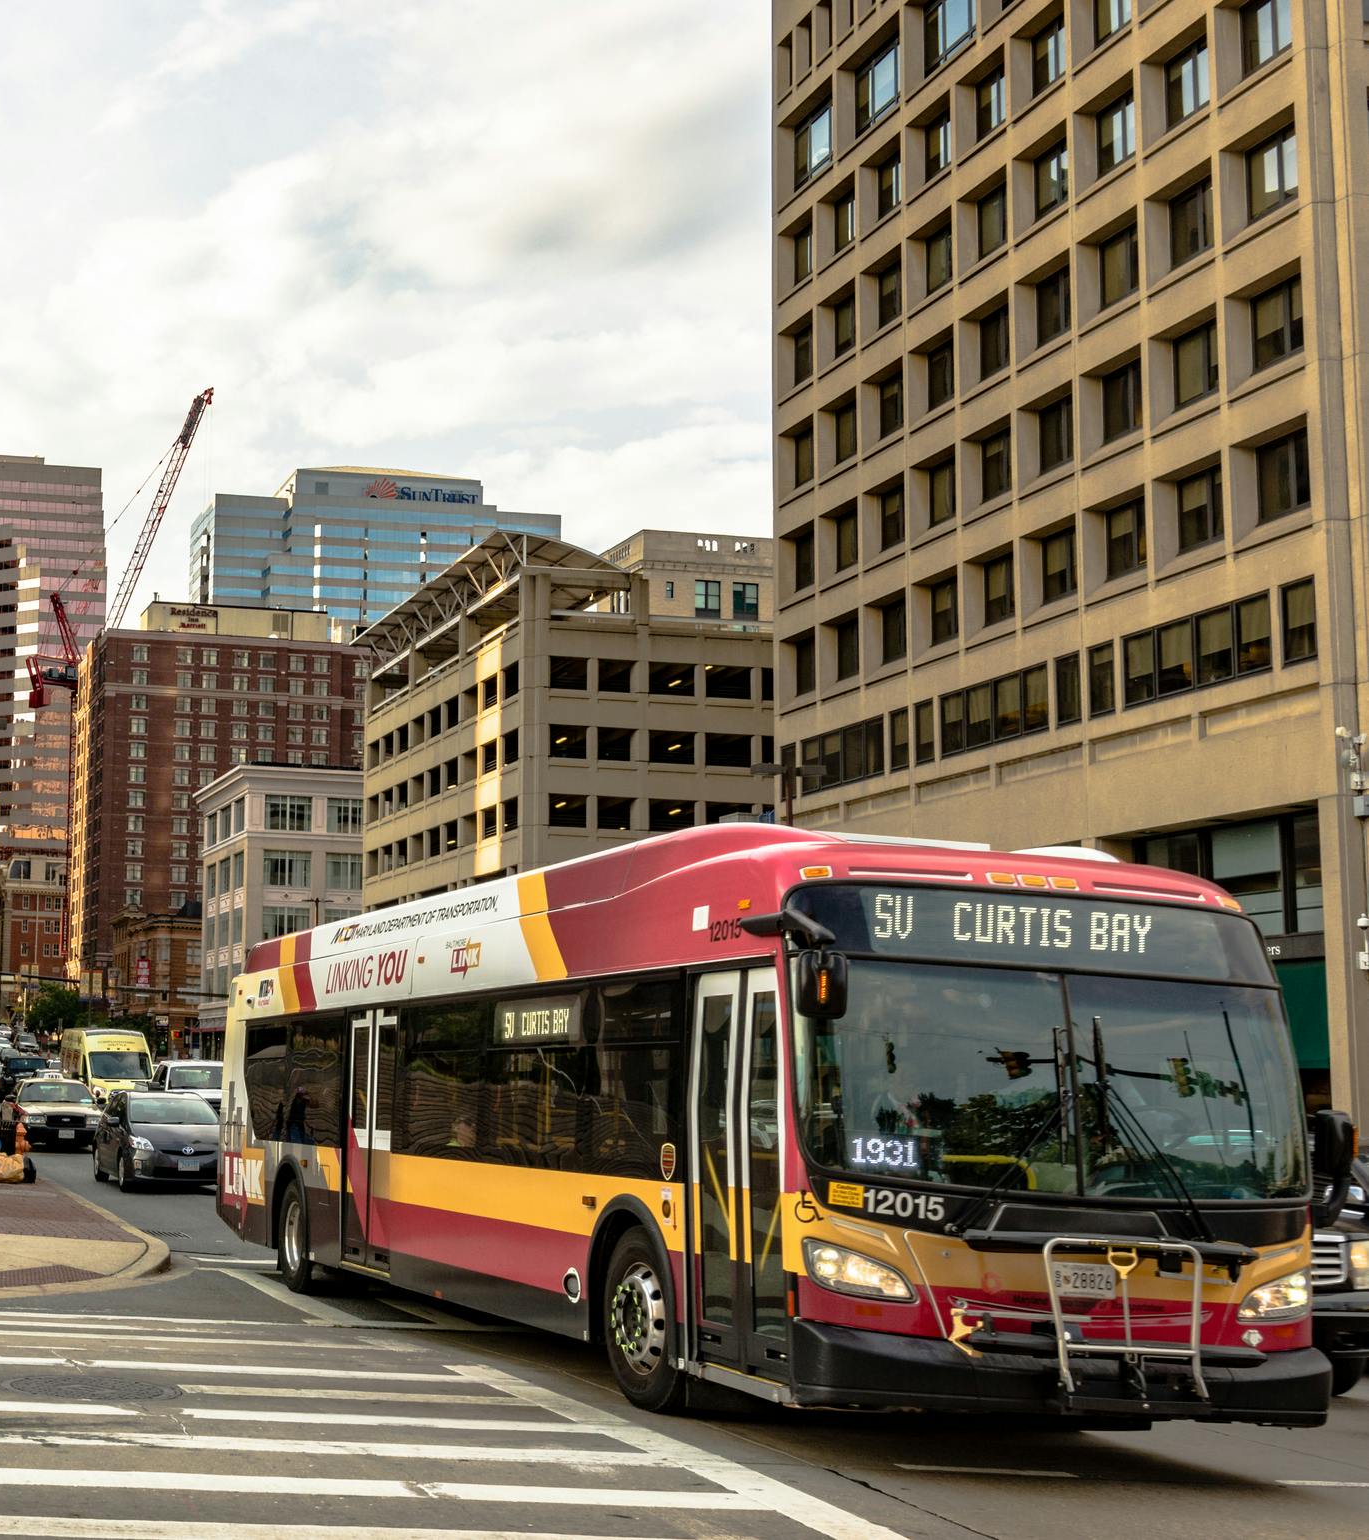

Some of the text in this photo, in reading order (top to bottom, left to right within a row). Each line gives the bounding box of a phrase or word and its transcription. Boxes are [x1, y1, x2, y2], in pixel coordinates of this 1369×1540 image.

[170, 607, 218, 618] Residence
[384, 912, 425, 933] DEPARTMENT
[424, 911, 436, 925] OF
[436, 896, 498, 922] TRANSPORTATION
[874, 894, 1152, 953] SV CURTIS BAY
[709, 918, 742, 942] 12015
[326, 949, 408, 994] LINKING YOU
[452, 948, 480, 968] LINK
[521, 1010, 550, 1036] CURTIS
[552, 1008, 569, 1034] BAY
[852, 1138, 917, 1166] 1931
[225, 1156, 265, 1201] LINK
[864, 1189, 945, 1221] 12015
[1072, 1272, 1112, 1290] 28826
